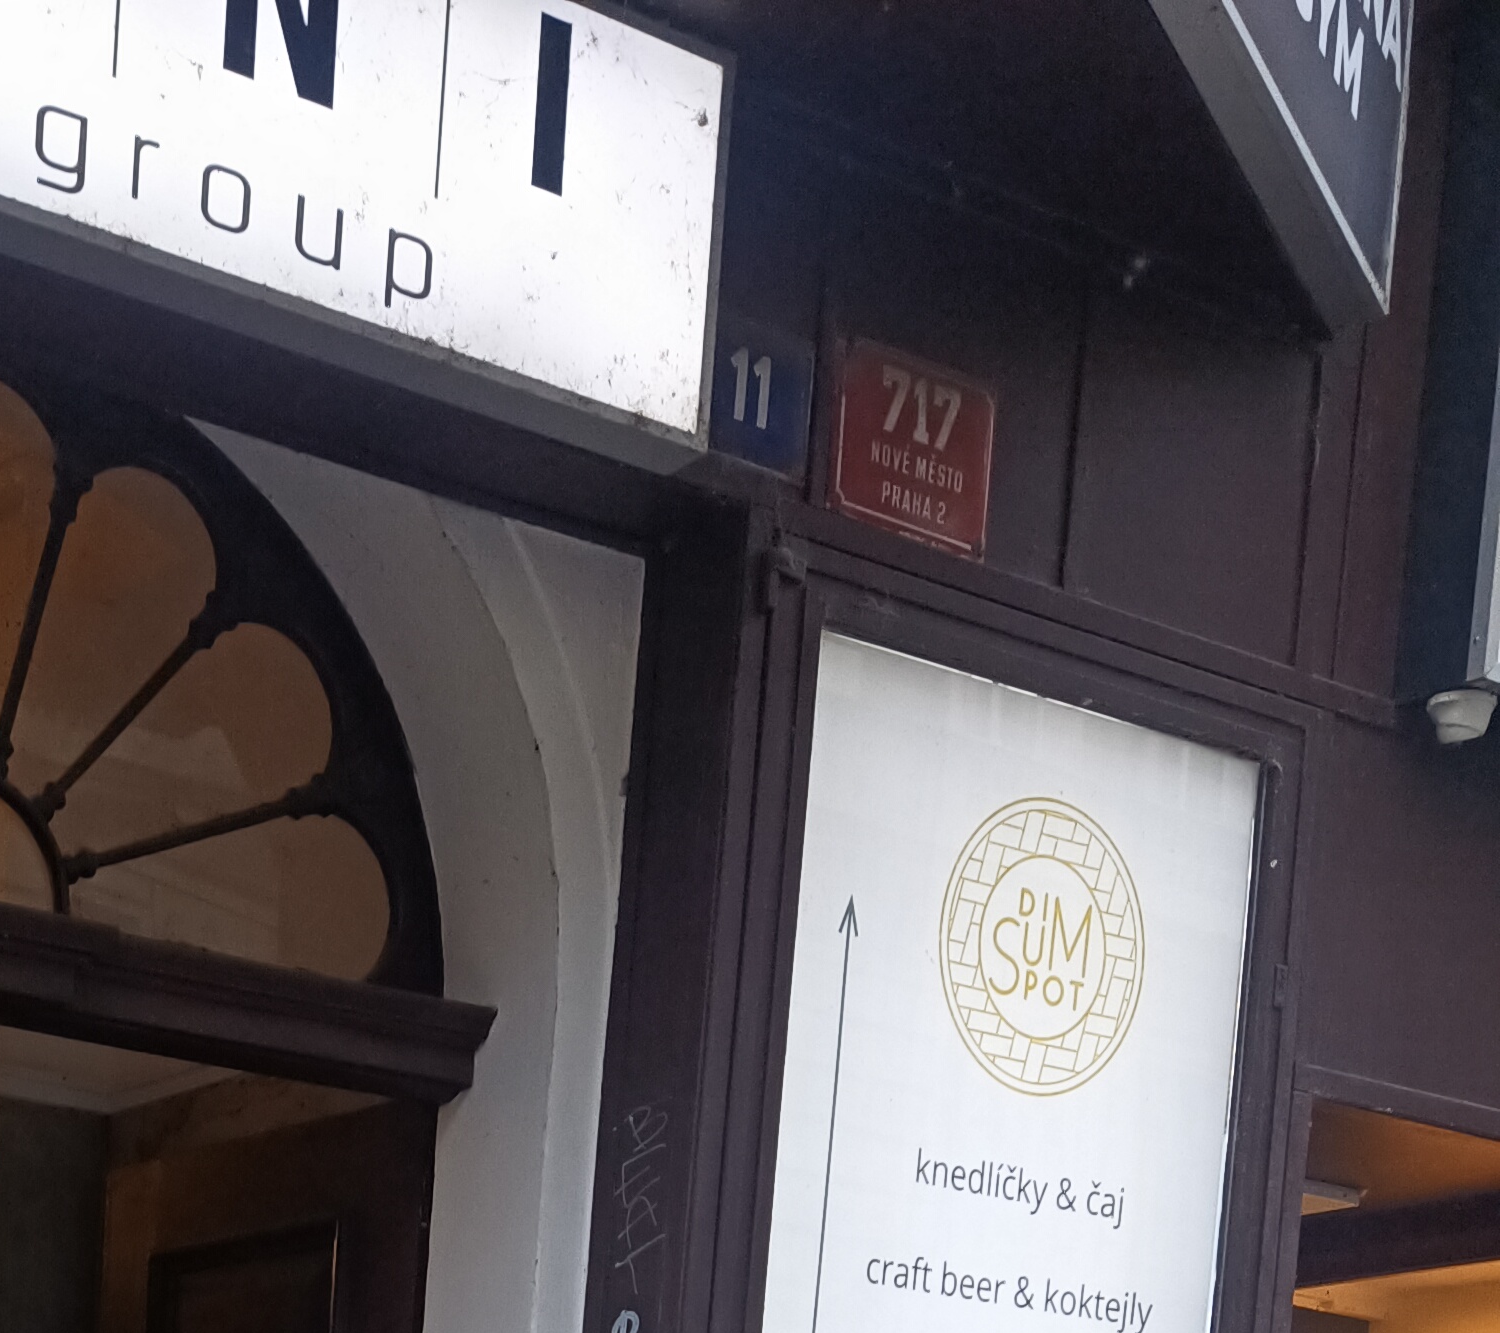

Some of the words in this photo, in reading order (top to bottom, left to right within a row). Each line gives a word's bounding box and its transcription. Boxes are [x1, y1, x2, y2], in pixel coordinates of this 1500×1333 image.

[36, 105, 433, 308] group
[730, 347, 771, 430] 11
[883, 364, 962, 451] 717
[871, 439, 910, 475] NOVÉ
[915, 455, 963, 493] MĚSTO
[882, 481, 931, 521] PRAHA
[936, 501, 946, 525] 2
[988, 896, 1092, 996] SUM
[915, 1147, 1048, 1215] knedlíčky
[1056, 1178, 1077, 1212] &
[1086, 1181, 1126, 1229] čaj
[866, 1256, 932, 1295] craft
[941, 1261, 1006, 1305] beer
[1014, 1277, 1034, 1310] &
